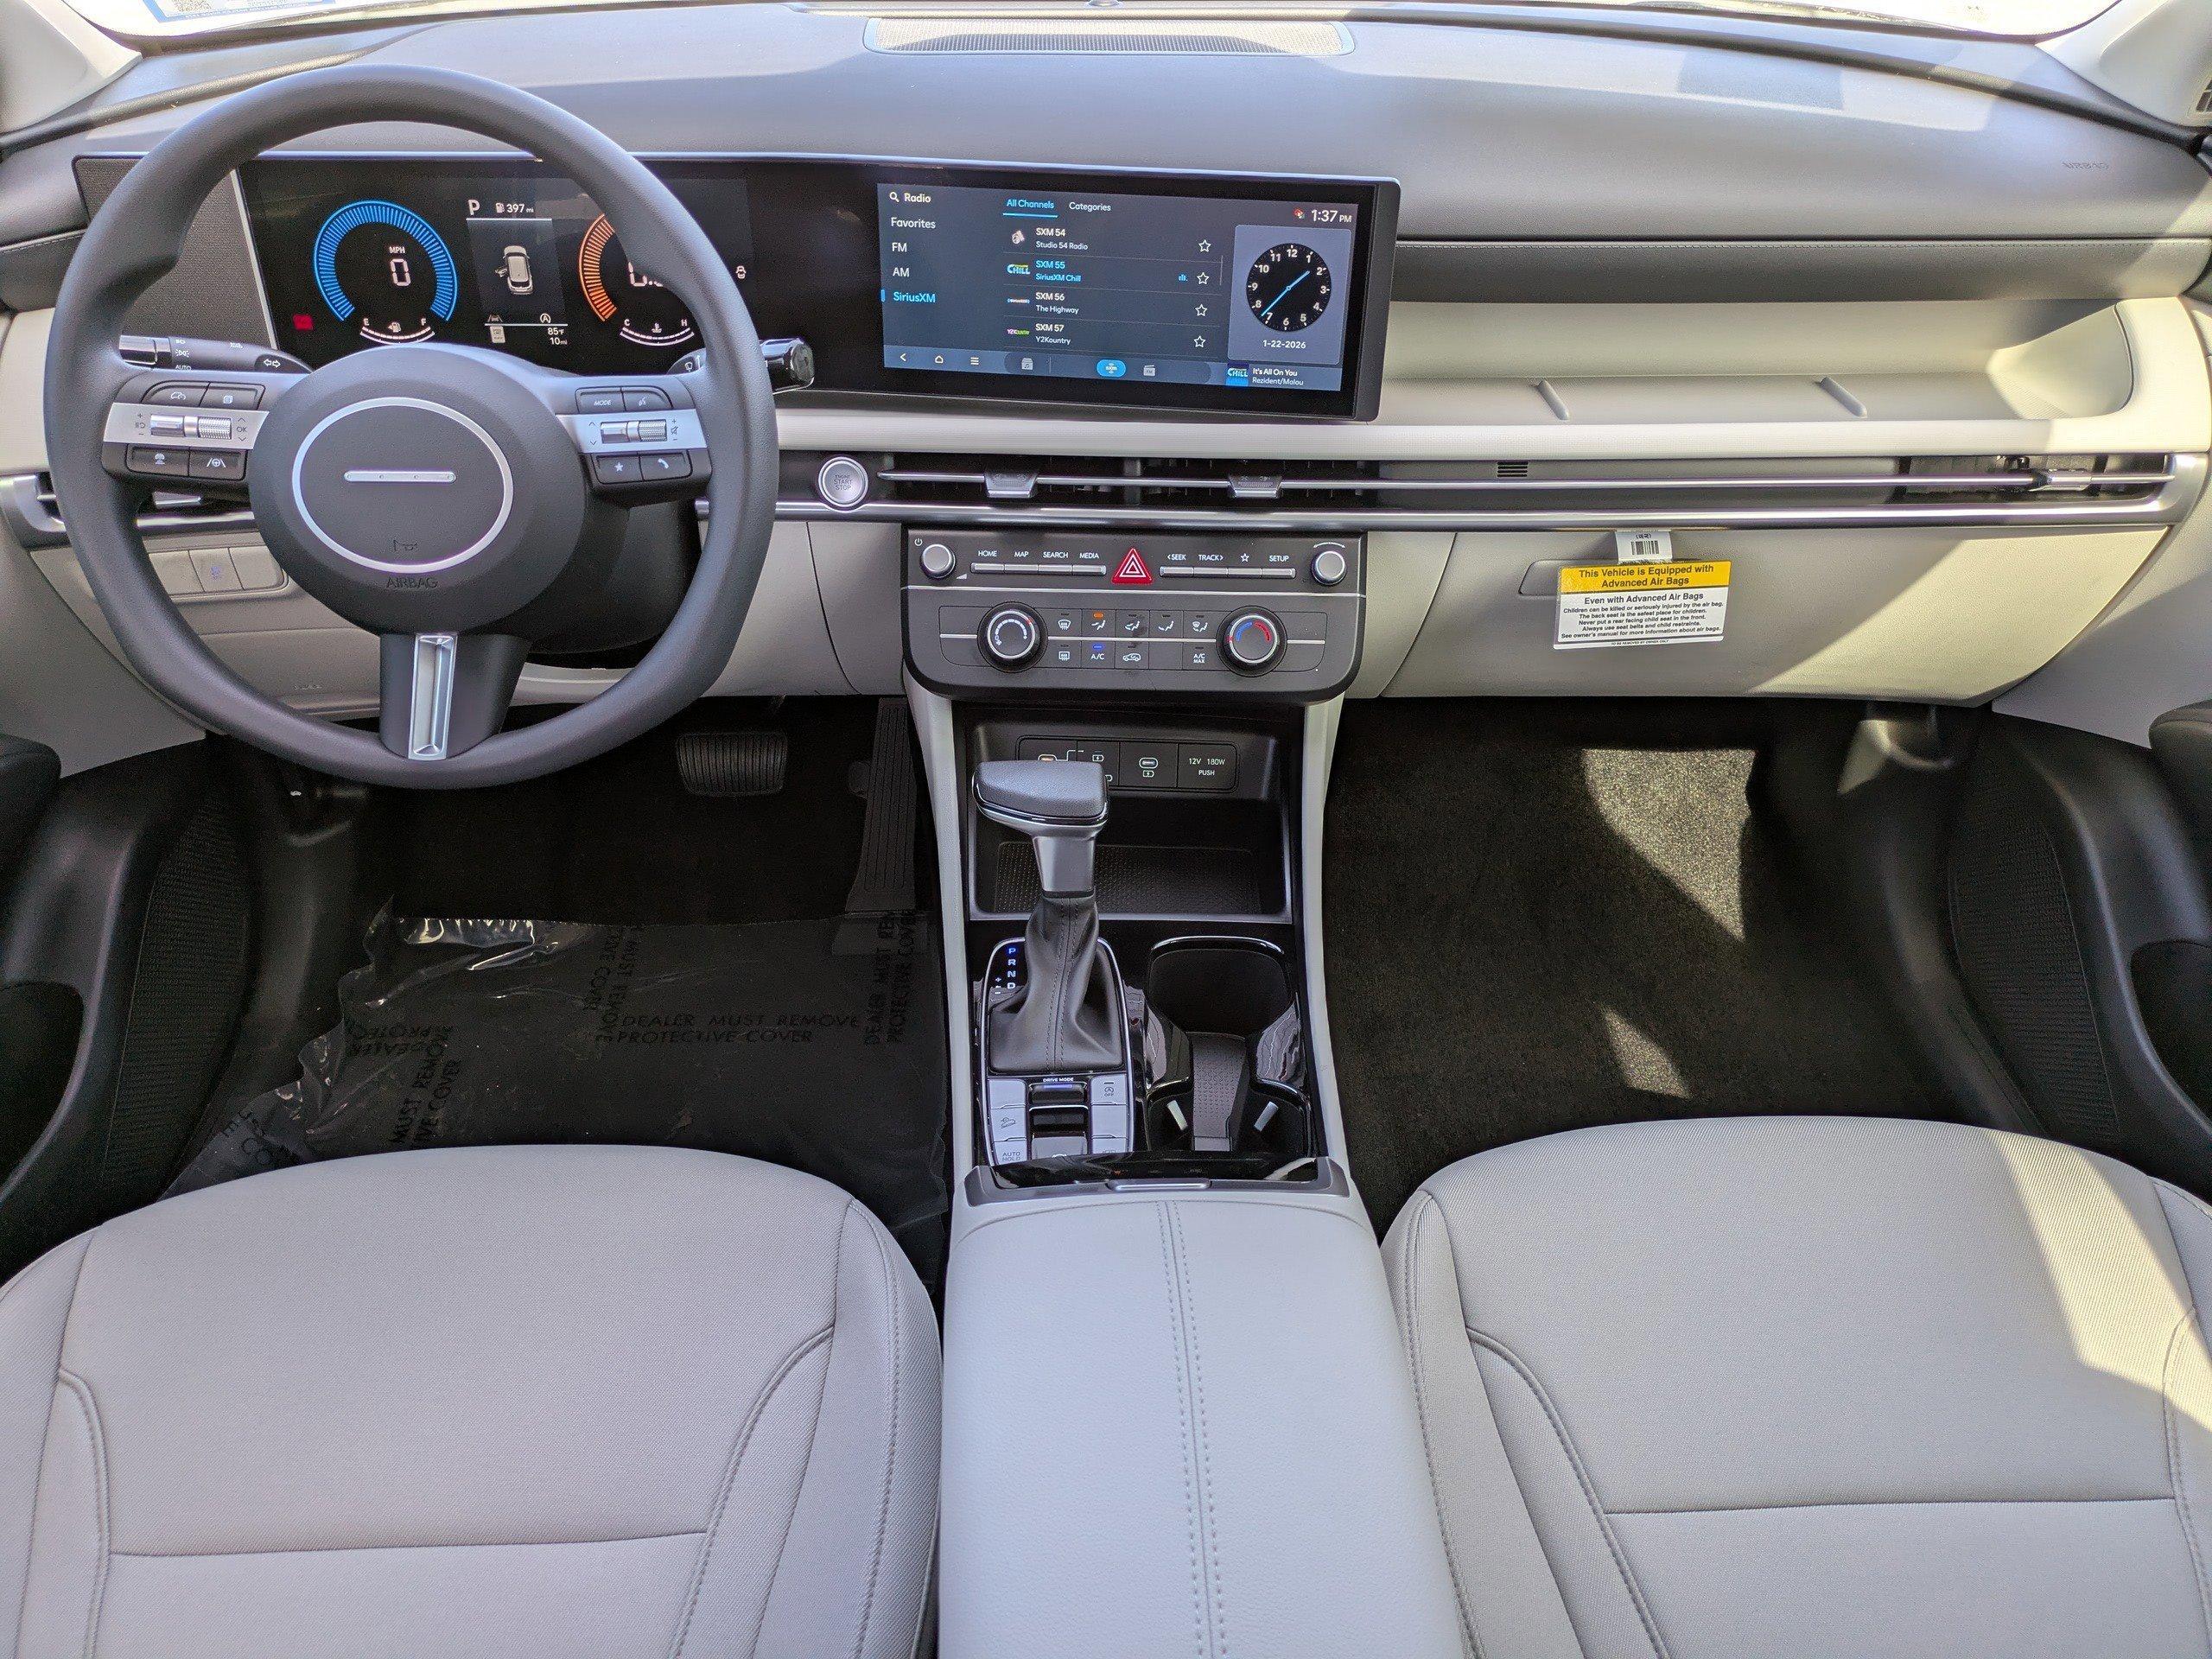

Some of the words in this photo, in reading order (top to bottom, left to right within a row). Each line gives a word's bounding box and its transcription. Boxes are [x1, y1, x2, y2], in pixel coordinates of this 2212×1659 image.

[905, 193, 931, 203] Radio
[467, 200, 480, 215] P
[506, 204, 524, 213] 397
[1018, 200, 1054, 209] Channels
[1069, 201, 1111, 212] Categories
[1311, 209, 1338, 222] 1:37
[891, 217, 936, 229] Favorites
[1036, 227, 1054, 237] SXM
[892, 242, 907, 252] FM
[1270, 253, 1281, 262] 11
[1287, 249, 1298, 258] 12
[1306, 255, 1312, 264] 1
[391, 258, 411, 287] 0
[893, 267, 910, 277] AM
[1007, 264, 1031, 275] CHILL
[1258, 264, 1270, 273] 10
[1316, 267, 1323, 276] 2
[1251, 282, 1258, 291] 9
[1320, 285, 1327, 295] 3
[893, 291, 936, 303] SiriusXM
[1036, 292, 1053, 301] SXM
[1255, 300, 1262, 308] 8
[1313, 302, 1320, 311] 4
[1050, 306, 1080, 315] Highway
[1267, 312, 1274, 321] 7
[1300, 313, 1307, 322] 5
[624, 318, 631, 327] C
[681, 319, 688, 327] H
[1283, 317, 1290, 327] 6
[1036, 323, 1053, 332] SXM
[1036, 336, 1071, 345] Y2Kountry
[1262, 340, 1306, 349] 1-22-2026
[1227, 368, 1249, 378] CHILL
[1253, 368, 1263, 377] It's
[1285, 369, 1298, 378] You
[1580, 569, 1599, 578] This
[1602, 568, 1635, 577] Vehicle
[1649, 566, 1693, 576] Equipped
[386, 577, 439, 589] AIRBAG
[1602, 579, 1648, 588] Advanced
[1666, 577, 1689, 587] Bags
[1626, 594, 1667, 603] Advanced
[1683, 593, 1704, 601] Bags
[1090, 652, 1105, 661] A/C
[1207, 758, 1225, 766] 180W
[622, 1014, 695, 1027] DEALER
[709, 1014, 765, 1027] MUST
[778, 1014, 860, 1027] REMOVE
[618, 1030, 736, 1044] PROTECTIVE
[746, 1029, 813, 1043] COVER
